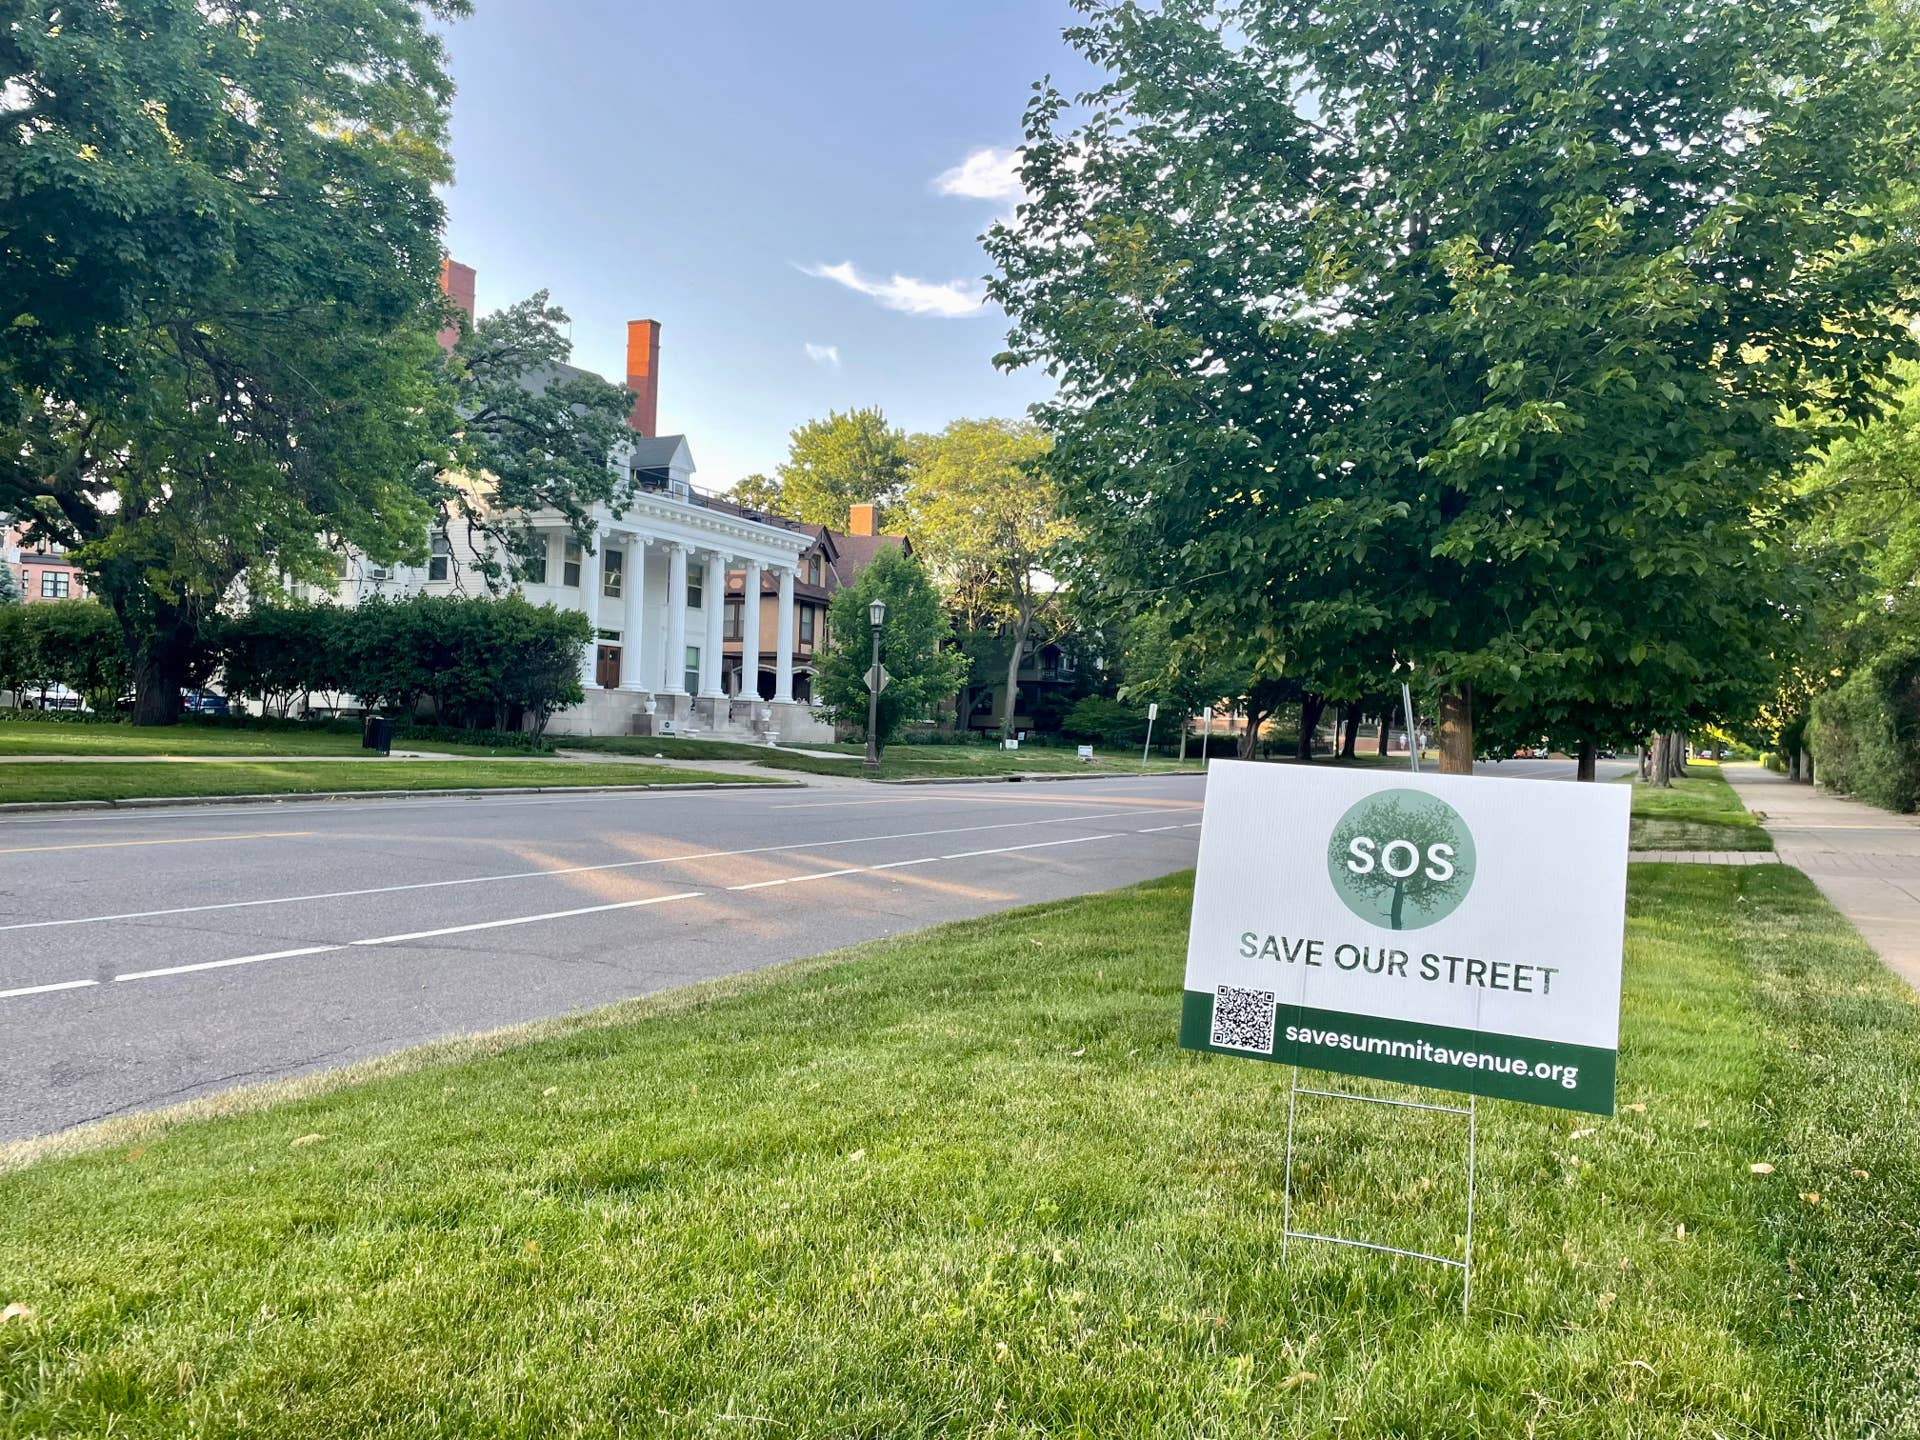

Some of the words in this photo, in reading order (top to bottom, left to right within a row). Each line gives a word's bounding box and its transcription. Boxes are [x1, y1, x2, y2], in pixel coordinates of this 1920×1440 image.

[1347, 836, 1454, 881] SOS
[1239, 931, 1324, 967] SAVE
[1334, 943, 1408, 977] OUR
[1419, 953, 1559, 995] STREET
[1285, 1025, 1579, 1088] savesummitavenue.org
